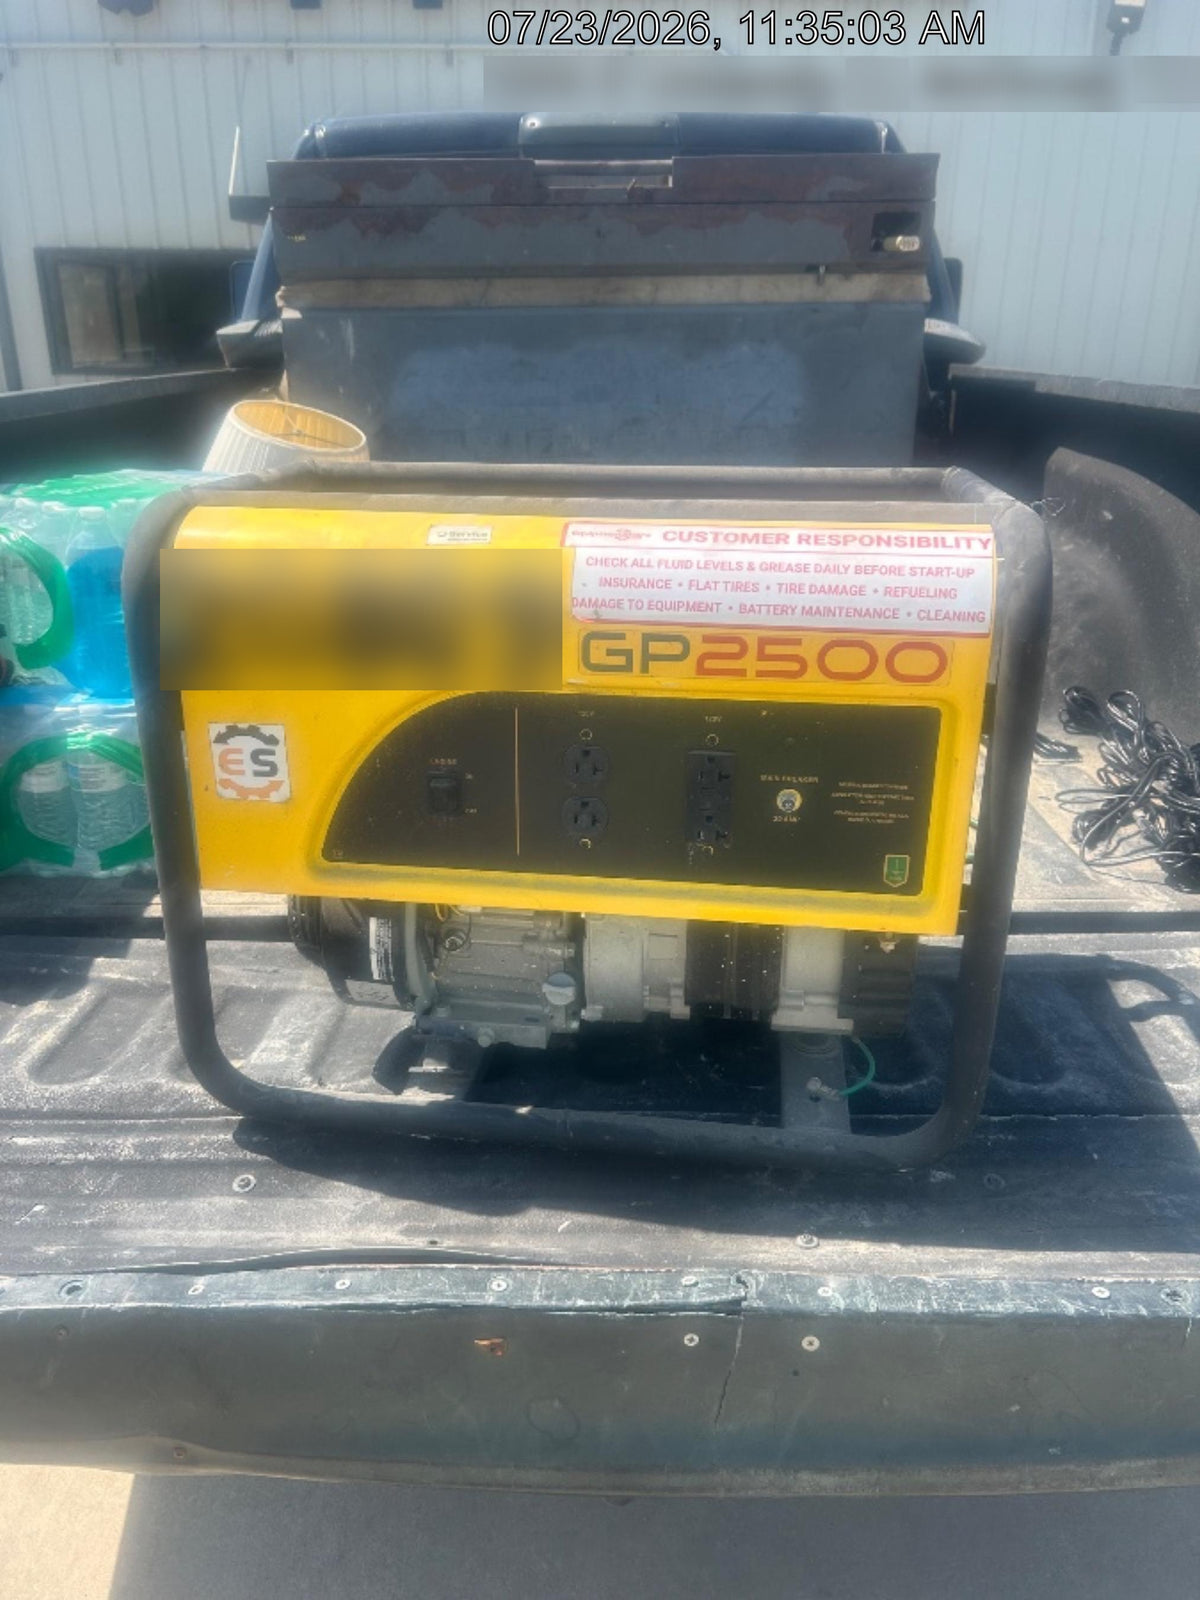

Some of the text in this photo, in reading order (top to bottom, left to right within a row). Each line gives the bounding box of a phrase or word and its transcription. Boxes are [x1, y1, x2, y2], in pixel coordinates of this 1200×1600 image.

[662, 530, 790, 545] CUSTOMER
[797, 533, 991, 550] RESPONSIBILITY
[586, 556, 975, 578] CHECK ALL FLUID LEVELS & GREASE DAILY BEFORE START-UP
[598, 576, 958, 600] INSURANCE FLAT TIRES TIRE DAMAGE REFUELING
[572, 596, 986, 623] DAMAGE TO EQUIPMENT BATTERY MAINTENANCE CLEANING
[580, 630, 949, 684] GP2500
